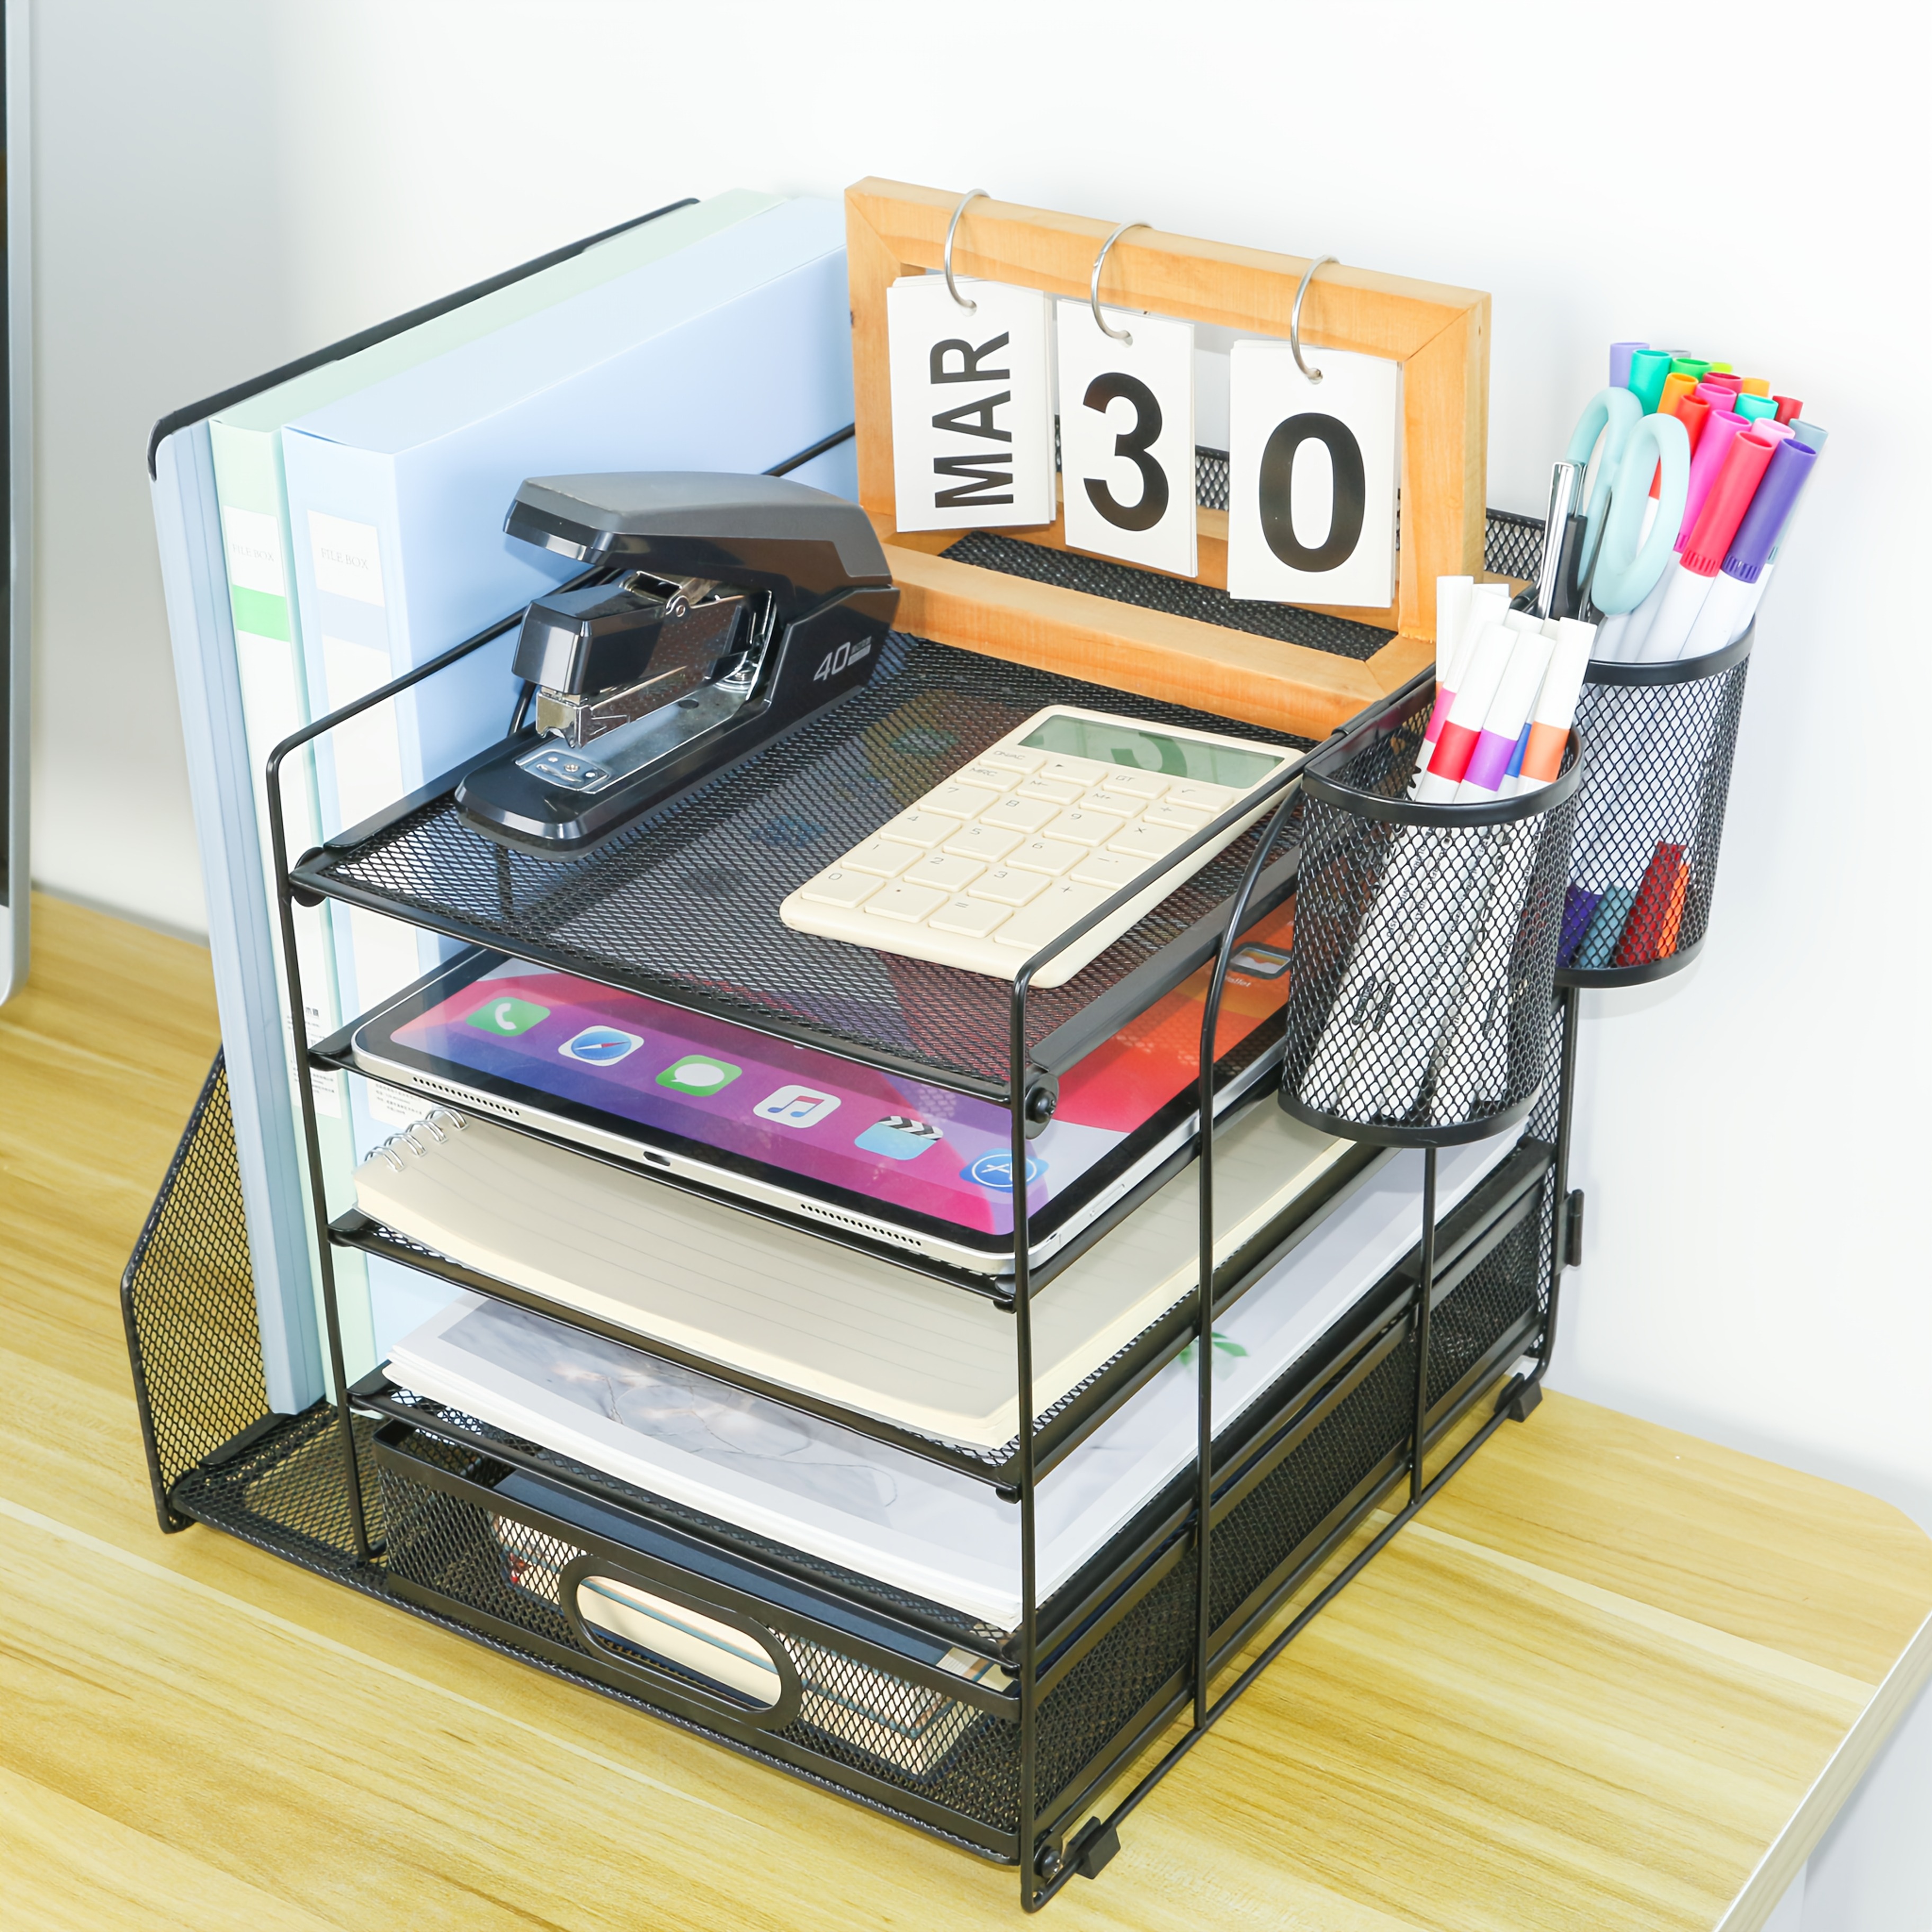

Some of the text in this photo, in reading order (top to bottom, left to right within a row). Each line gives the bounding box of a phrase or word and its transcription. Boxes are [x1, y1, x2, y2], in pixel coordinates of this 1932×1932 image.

[929, 331, 1014, 508] MAR
[1082, 372, 1169, 532] 3
[1258, 412, 1366, 573] 0
[232, 543, 274, 562] FILE BOX
[321, 547, 369, 570] FILE BOX
[813, 641, 851, 682] 40
[969, 767, 998, 777] MRC
[828, 872, 843, 881] 0
[994, 871, 1008, 879] 3
